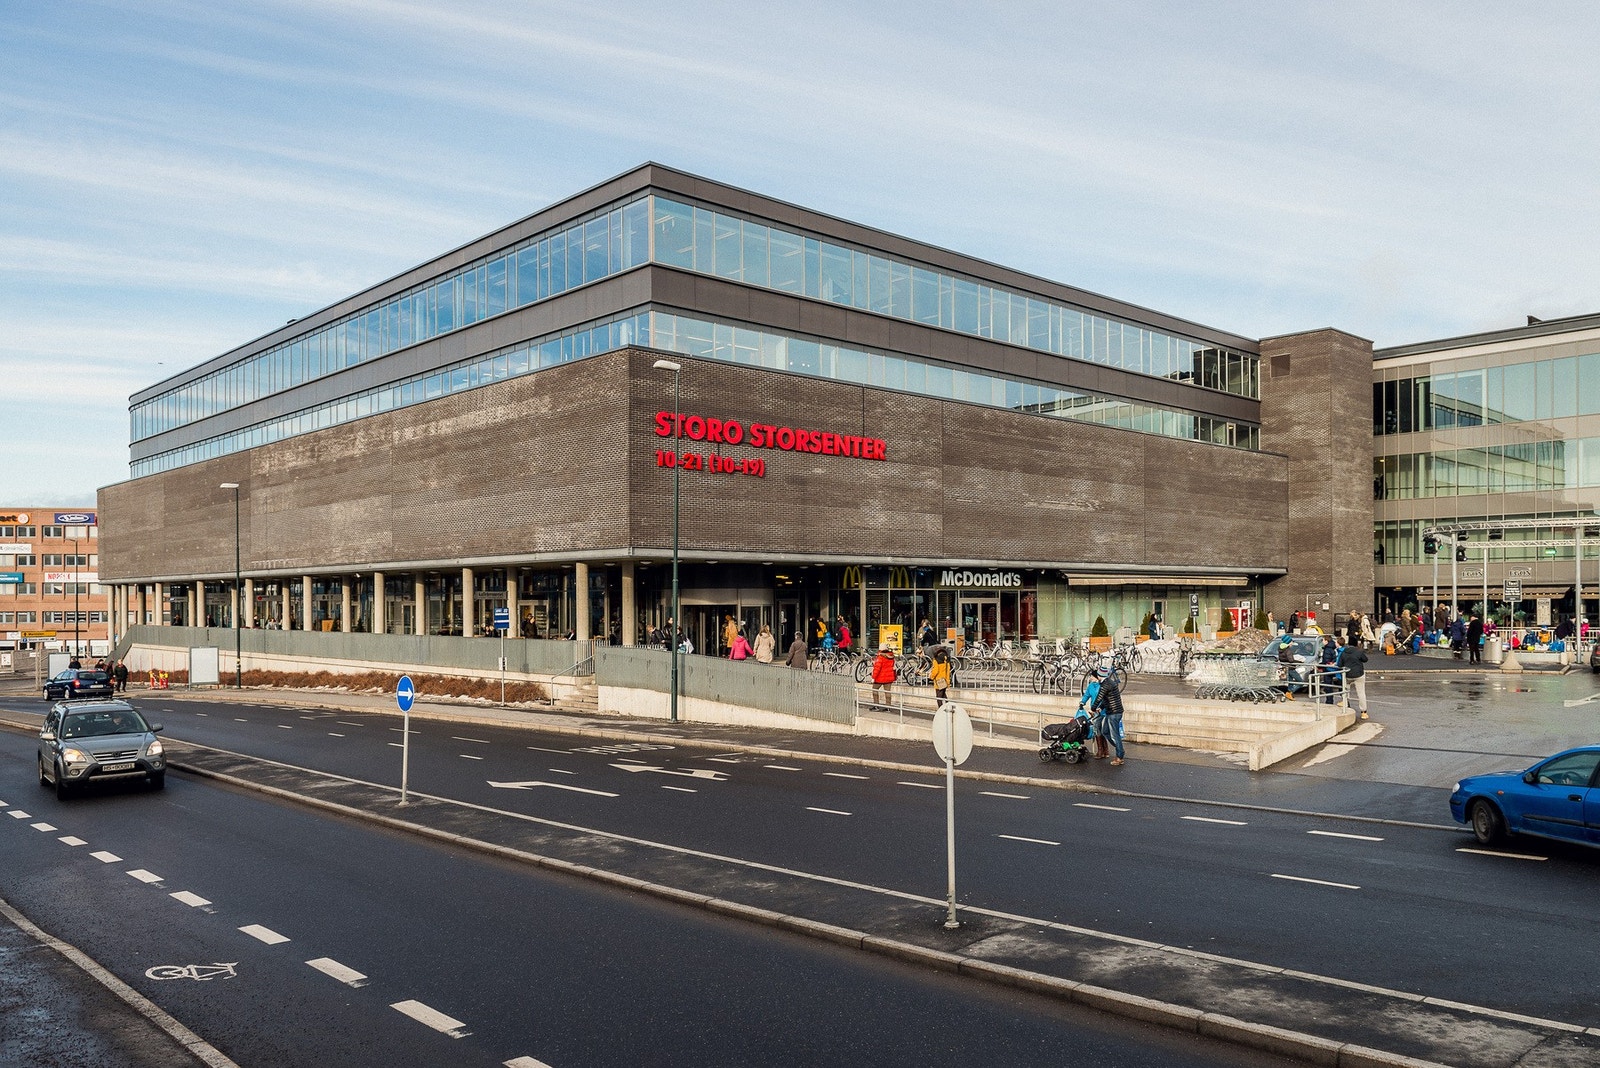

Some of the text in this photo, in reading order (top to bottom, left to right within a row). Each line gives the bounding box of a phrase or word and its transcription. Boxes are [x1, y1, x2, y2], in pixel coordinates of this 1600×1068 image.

[655, 411, 887, 461] STORO STORSENTER
[655, 450, 765, 477] 10-21 (10-19)
[940, 570, 1021, 587] McDonald's
